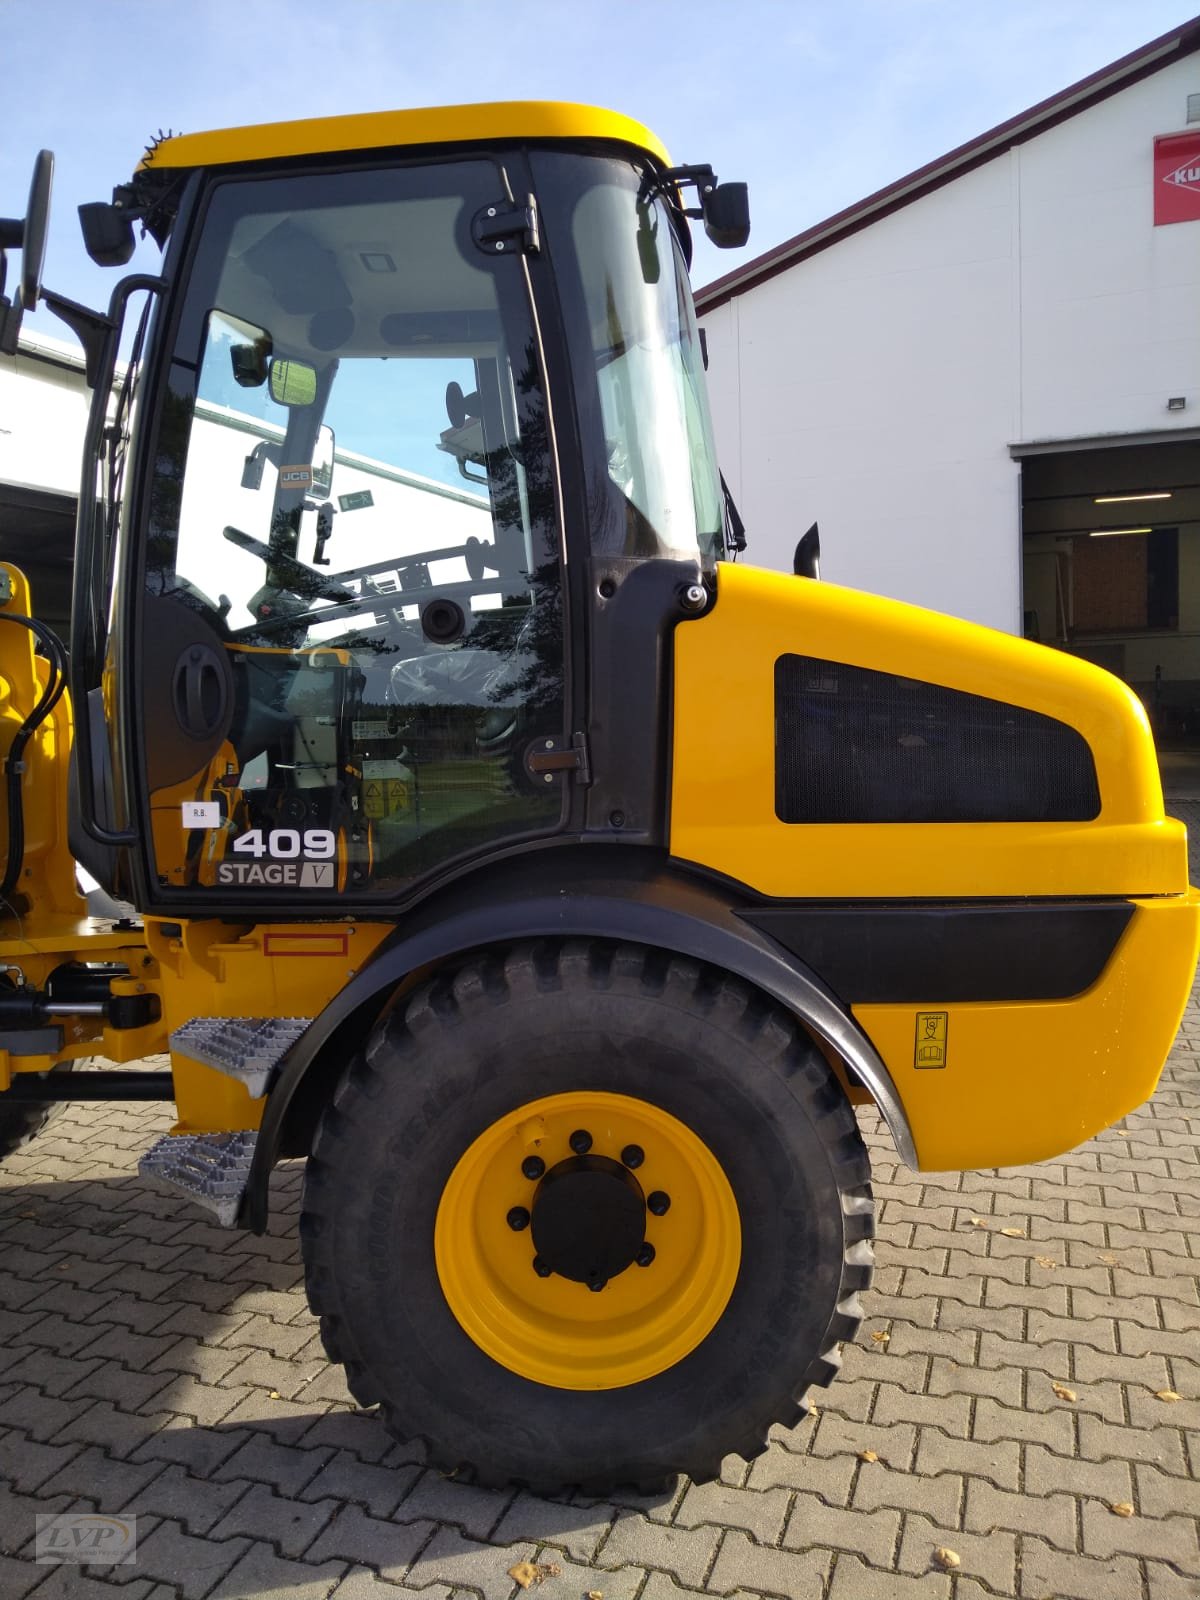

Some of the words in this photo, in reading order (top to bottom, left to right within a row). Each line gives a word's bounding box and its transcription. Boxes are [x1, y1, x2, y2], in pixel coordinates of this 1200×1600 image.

[283, 472, 310, 481] JCB
[193, 808, 208, 817] R.B.
[234, 829, 336, 859] 409
[219, 864, 297, 884] STAGE
[312, 865, 327, 884] V
